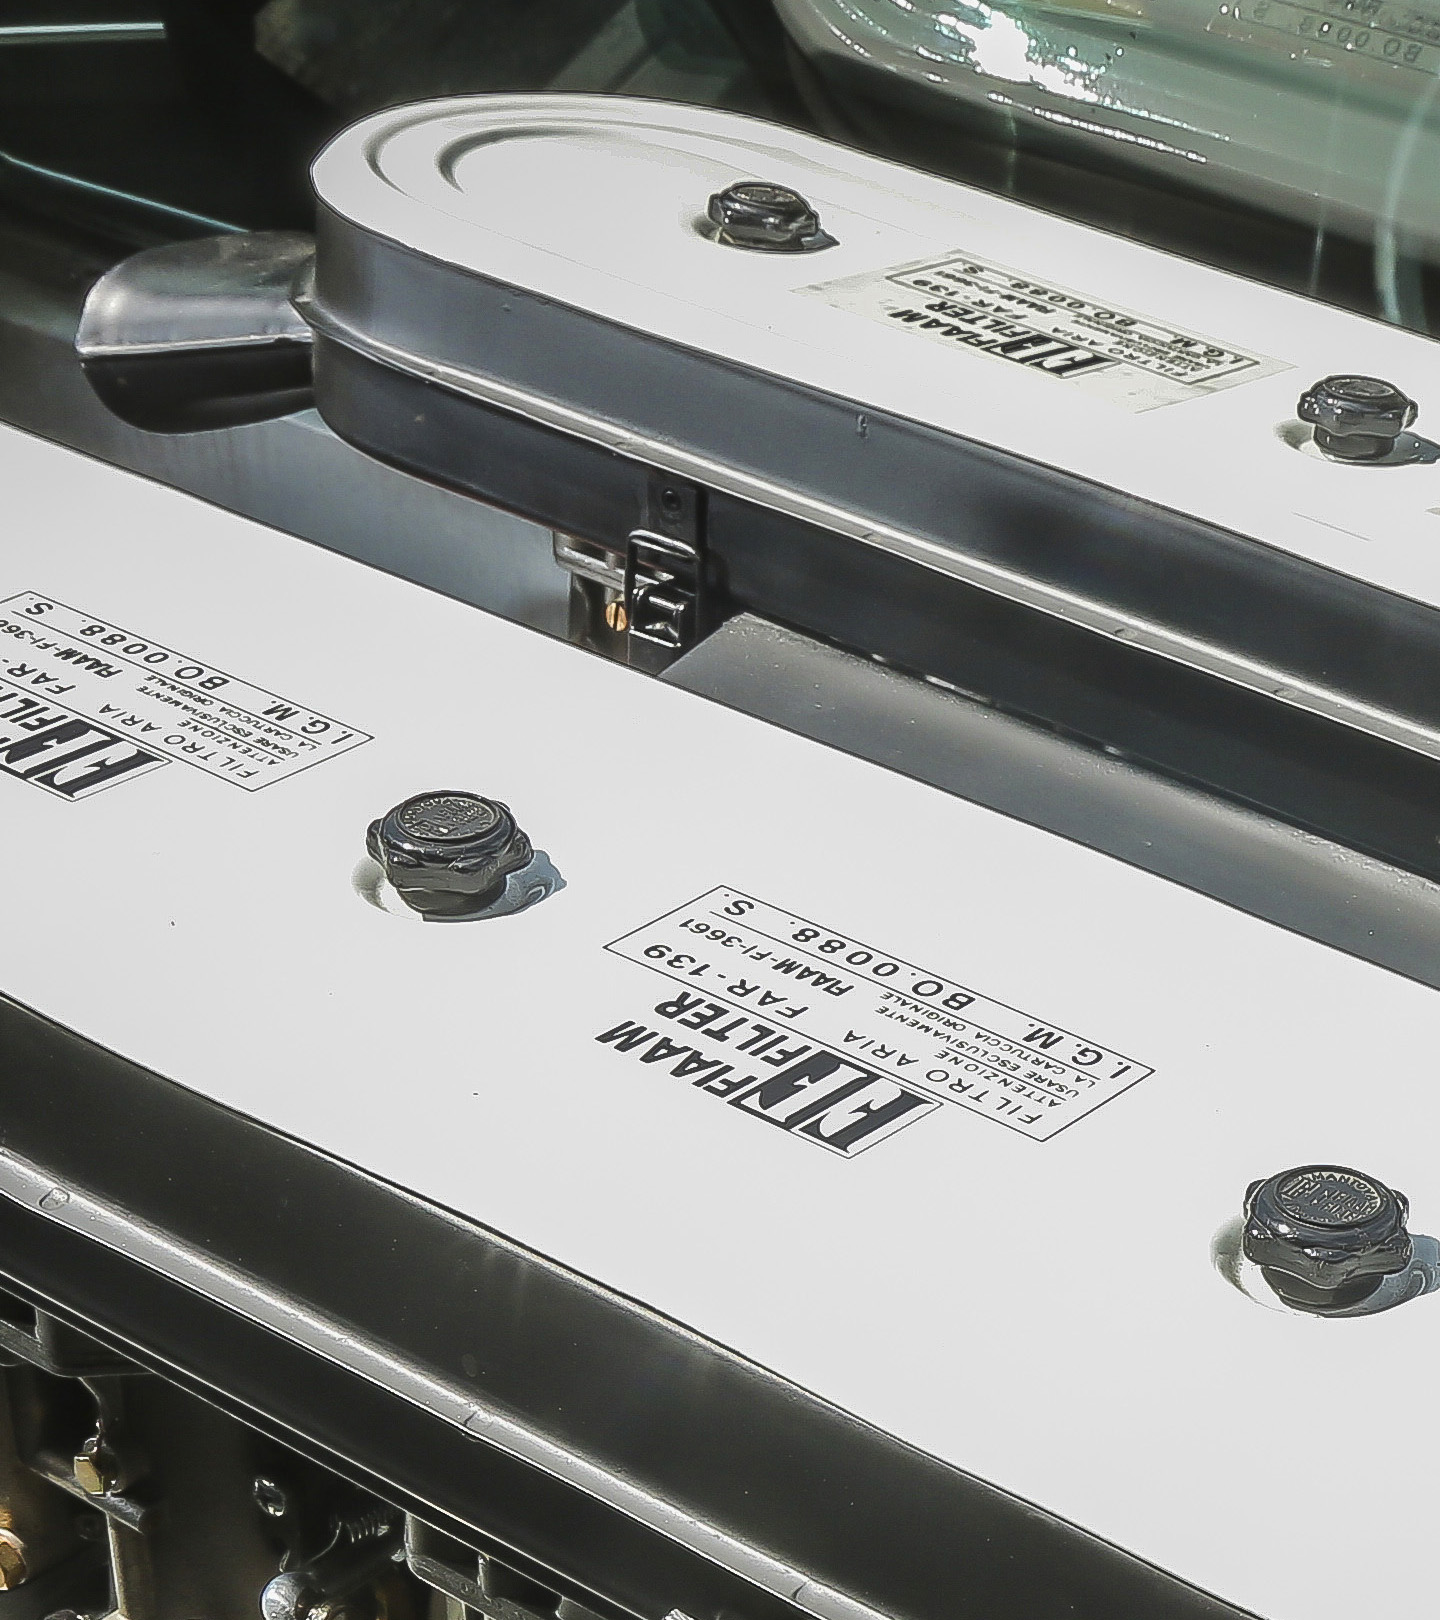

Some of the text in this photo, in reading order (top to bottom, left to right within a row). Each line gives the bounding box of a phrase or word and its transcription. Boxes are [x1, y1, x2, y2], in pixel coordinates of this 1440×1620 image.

[887, 309, 1000, 348] FIAAM
[925, 301, 1032, 338] FILTER
[98, 703, 162, 733] ARIA
[136, 685, 299, 759] USARE ESCLUSIVAMENTE
[143, 674, 317, 751] LA CARTUCCIA ORIGINALE
[163, 734, 260, 779] FILTRO
[177, 719, 280, 766] ATTENZIONE
[677, 918, 855, 997] FIAAM-FI-3661
[593, 1020, 758, 1098] FIAAM
[653, 991, 812, 1068] FILTER
[841, 1028, 919, 1067] ARIA
[874, 1005, 1080, 1098] USARE ESCLUSIVAMENTE
[879, 991, 1096, 1089] LA CARTUCCIA ORIGINALE
[925, 1069, 1043, 1125] FILTRO
[933, 1049, 1062, 1108] ATTENZIONE
